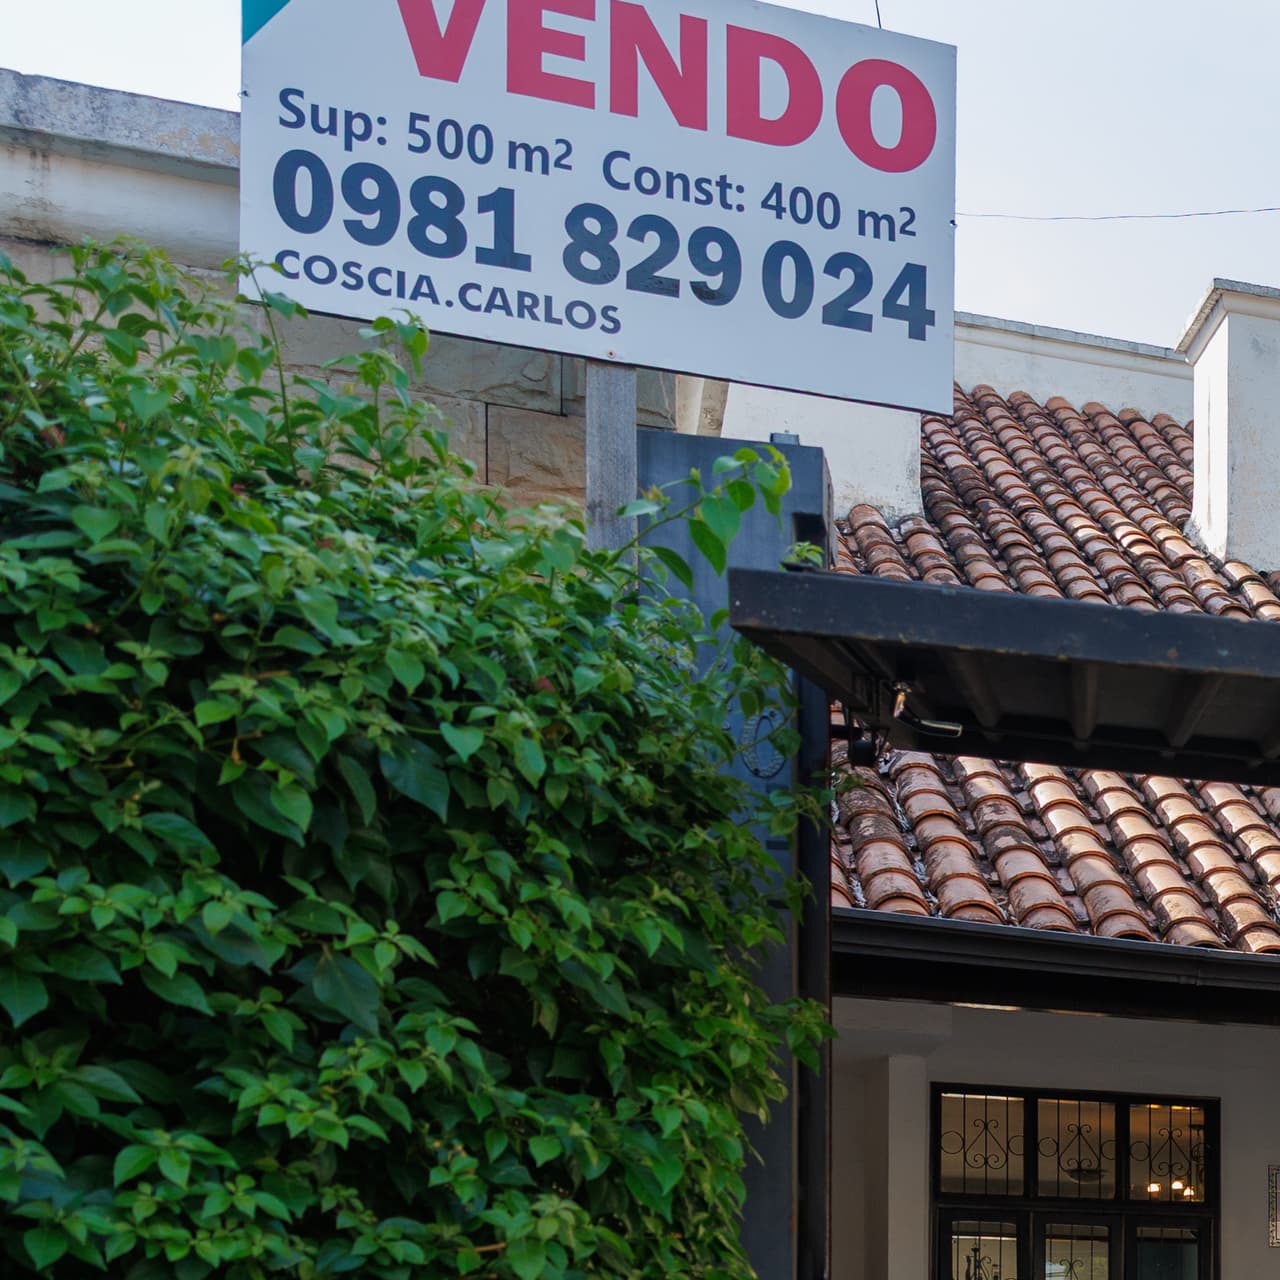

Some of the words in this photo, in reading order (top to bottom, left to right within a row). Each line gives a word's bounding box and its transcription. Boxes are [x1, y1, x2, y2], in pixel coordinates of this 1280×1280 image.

[278, 87, 388, 153] Sup:
[406, 111, 494, 165] 500
[602, 150, 746, 214] Const:
[760, 181, 841, 230] 400
[397, 0, 937, 174] VENDO
[272, 148, 532, 273] 0981
[562, 202, 742, 307] 829
[761, 239, 936, 342] 024
[275, 249, 622, 335] COSCIA.CARLOS
